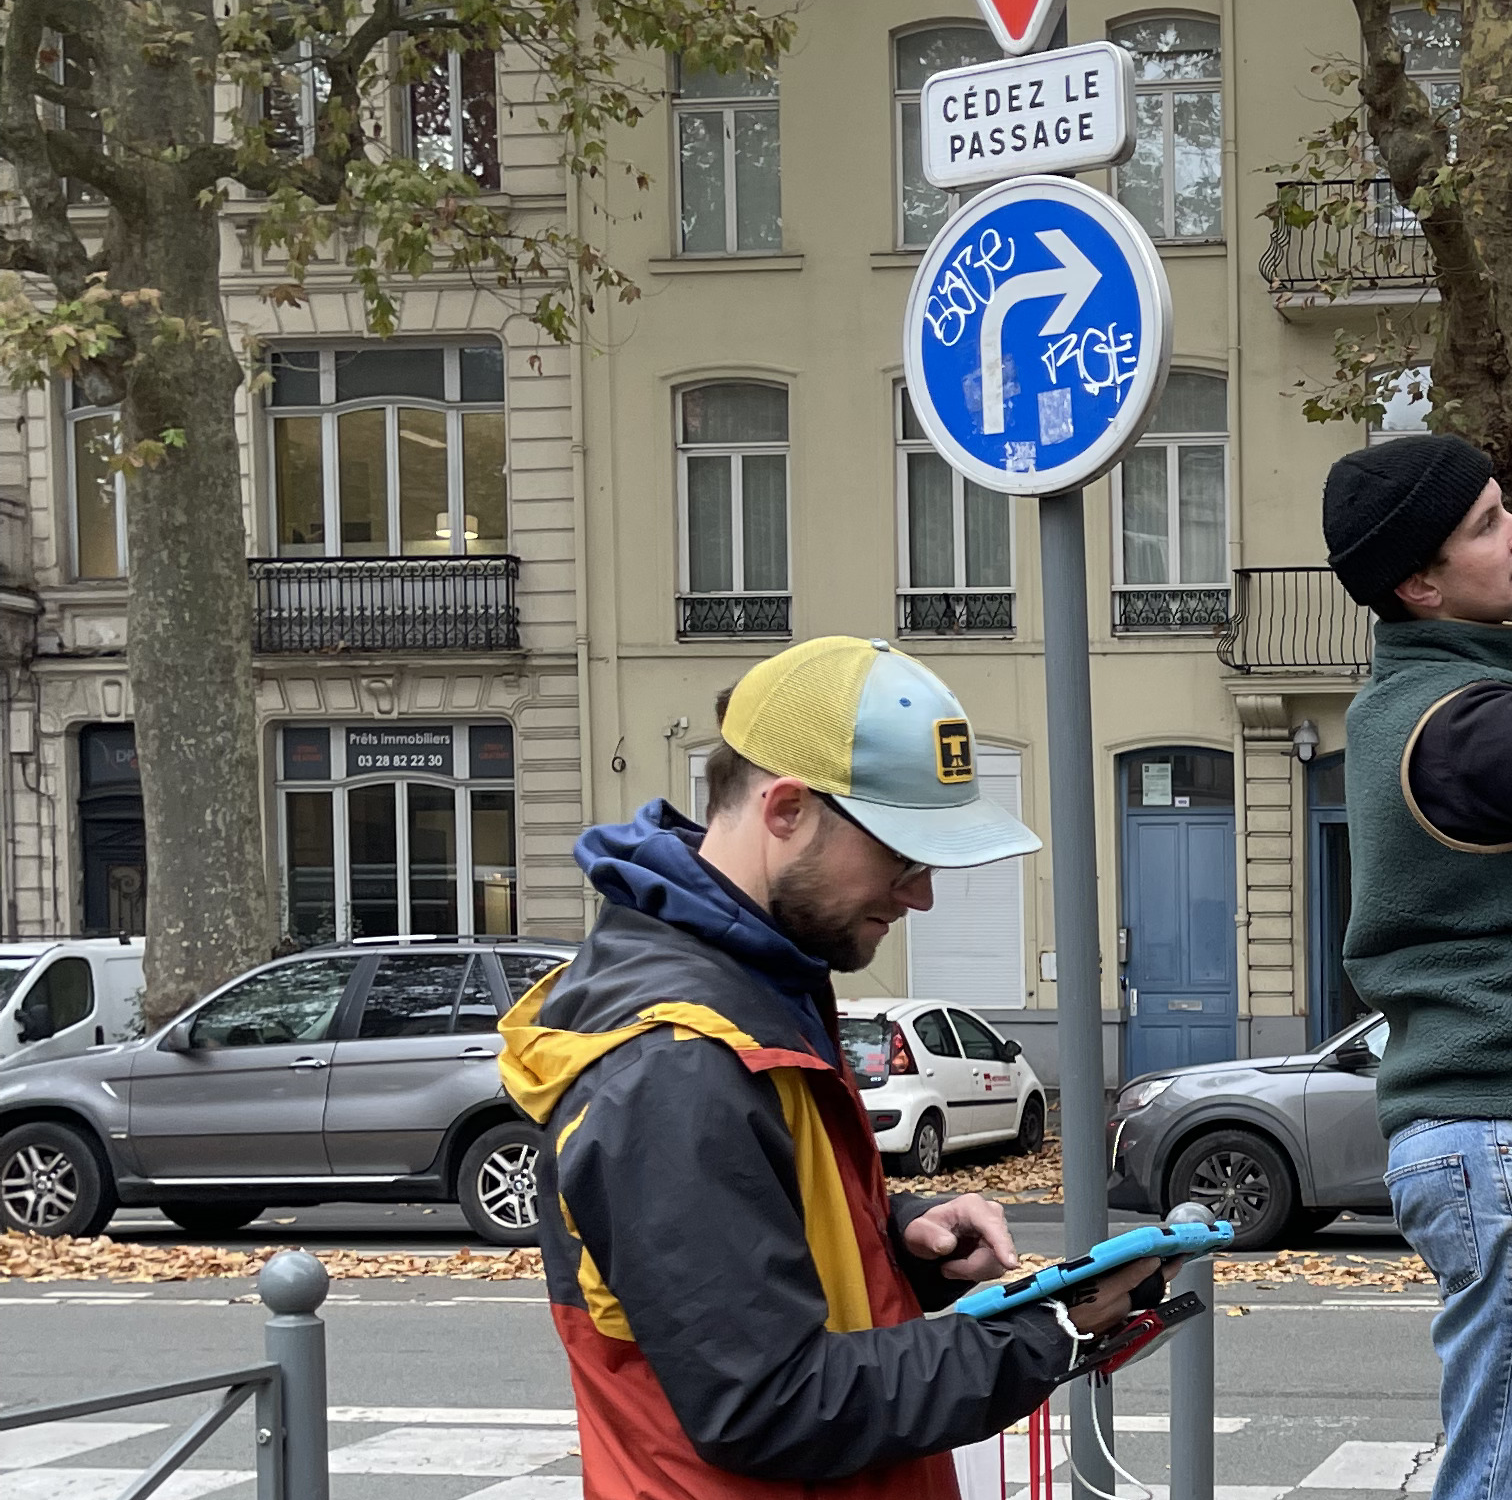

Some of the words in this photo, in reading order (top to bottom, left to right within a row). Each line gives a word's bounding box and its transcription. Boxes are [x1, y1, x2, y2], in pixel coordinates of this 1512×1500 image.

[942, 79, 1045, 123] CÉDEZ
[1064, 69, 1100, 103] LE
[949, 112, 1094, 163] PASSAGE
[350, 732, 378, 745] Prêts
[358, 754, 372, 767] 03
[376, 754, 390, 767] 28
[393, 754, 407, 767] 82
[411, 754, 425, 767] 22
[428, 754, 443, 767] 30
